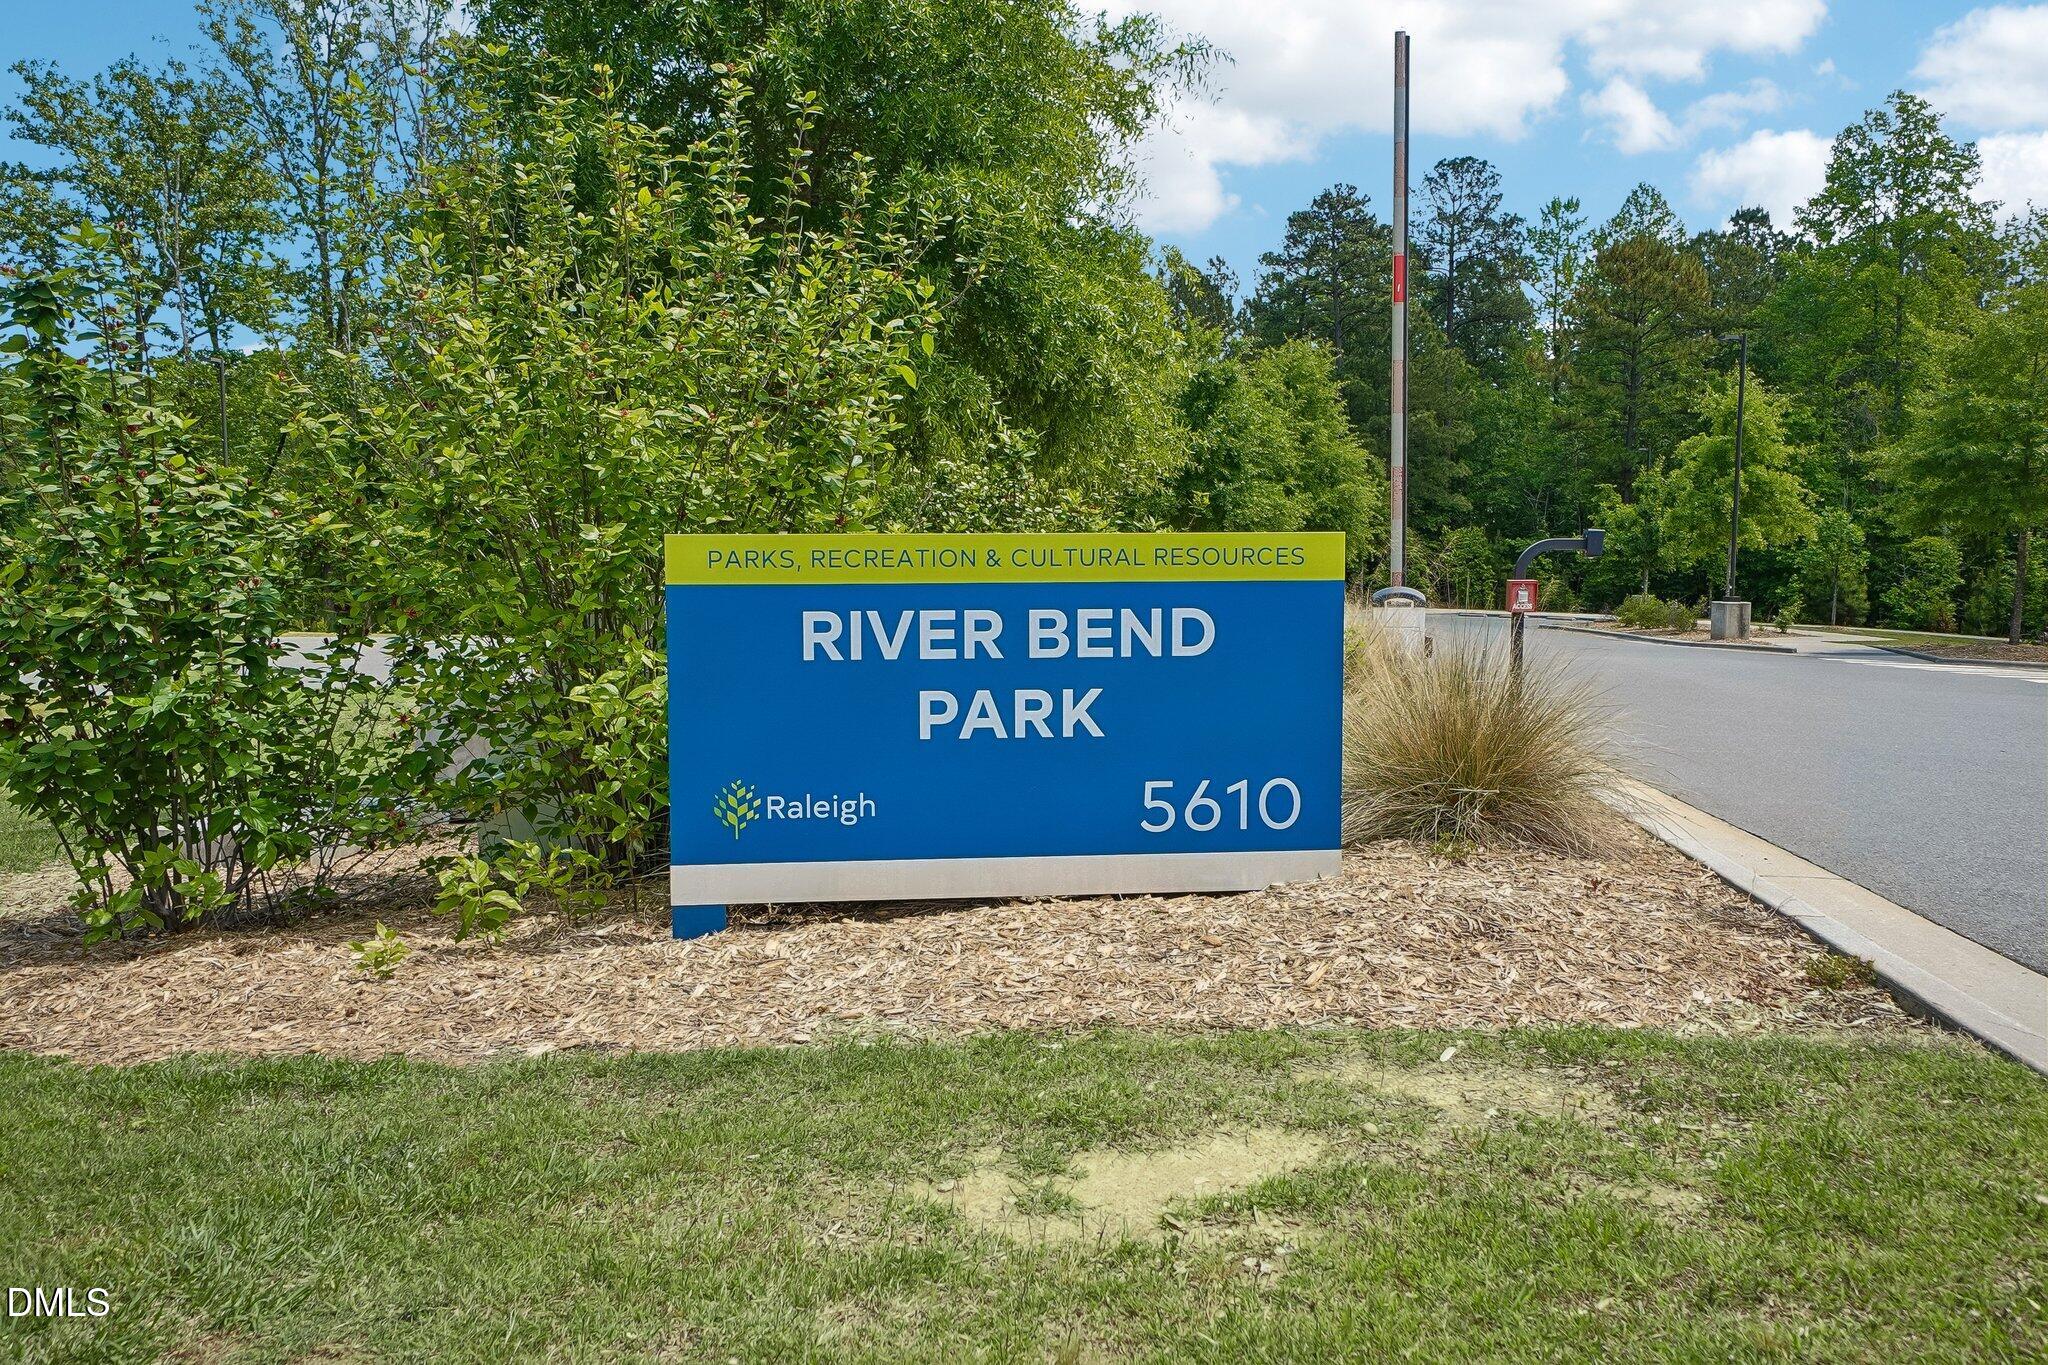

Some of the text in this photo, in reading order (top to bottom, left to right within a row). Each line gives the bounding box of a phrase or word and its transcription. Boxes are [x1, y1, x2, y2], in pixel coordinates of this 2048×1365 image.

[708, 546, 1305, 573] PARKS, RECREATION & CULTURAL RESOURCES
[802, 607, 1216, 661] RIVER BEND
[919, 688, 1105, 740] PARK
[767, 792, 876, 826] Raleigh
[1140, 777, 1301, 833] 5610
